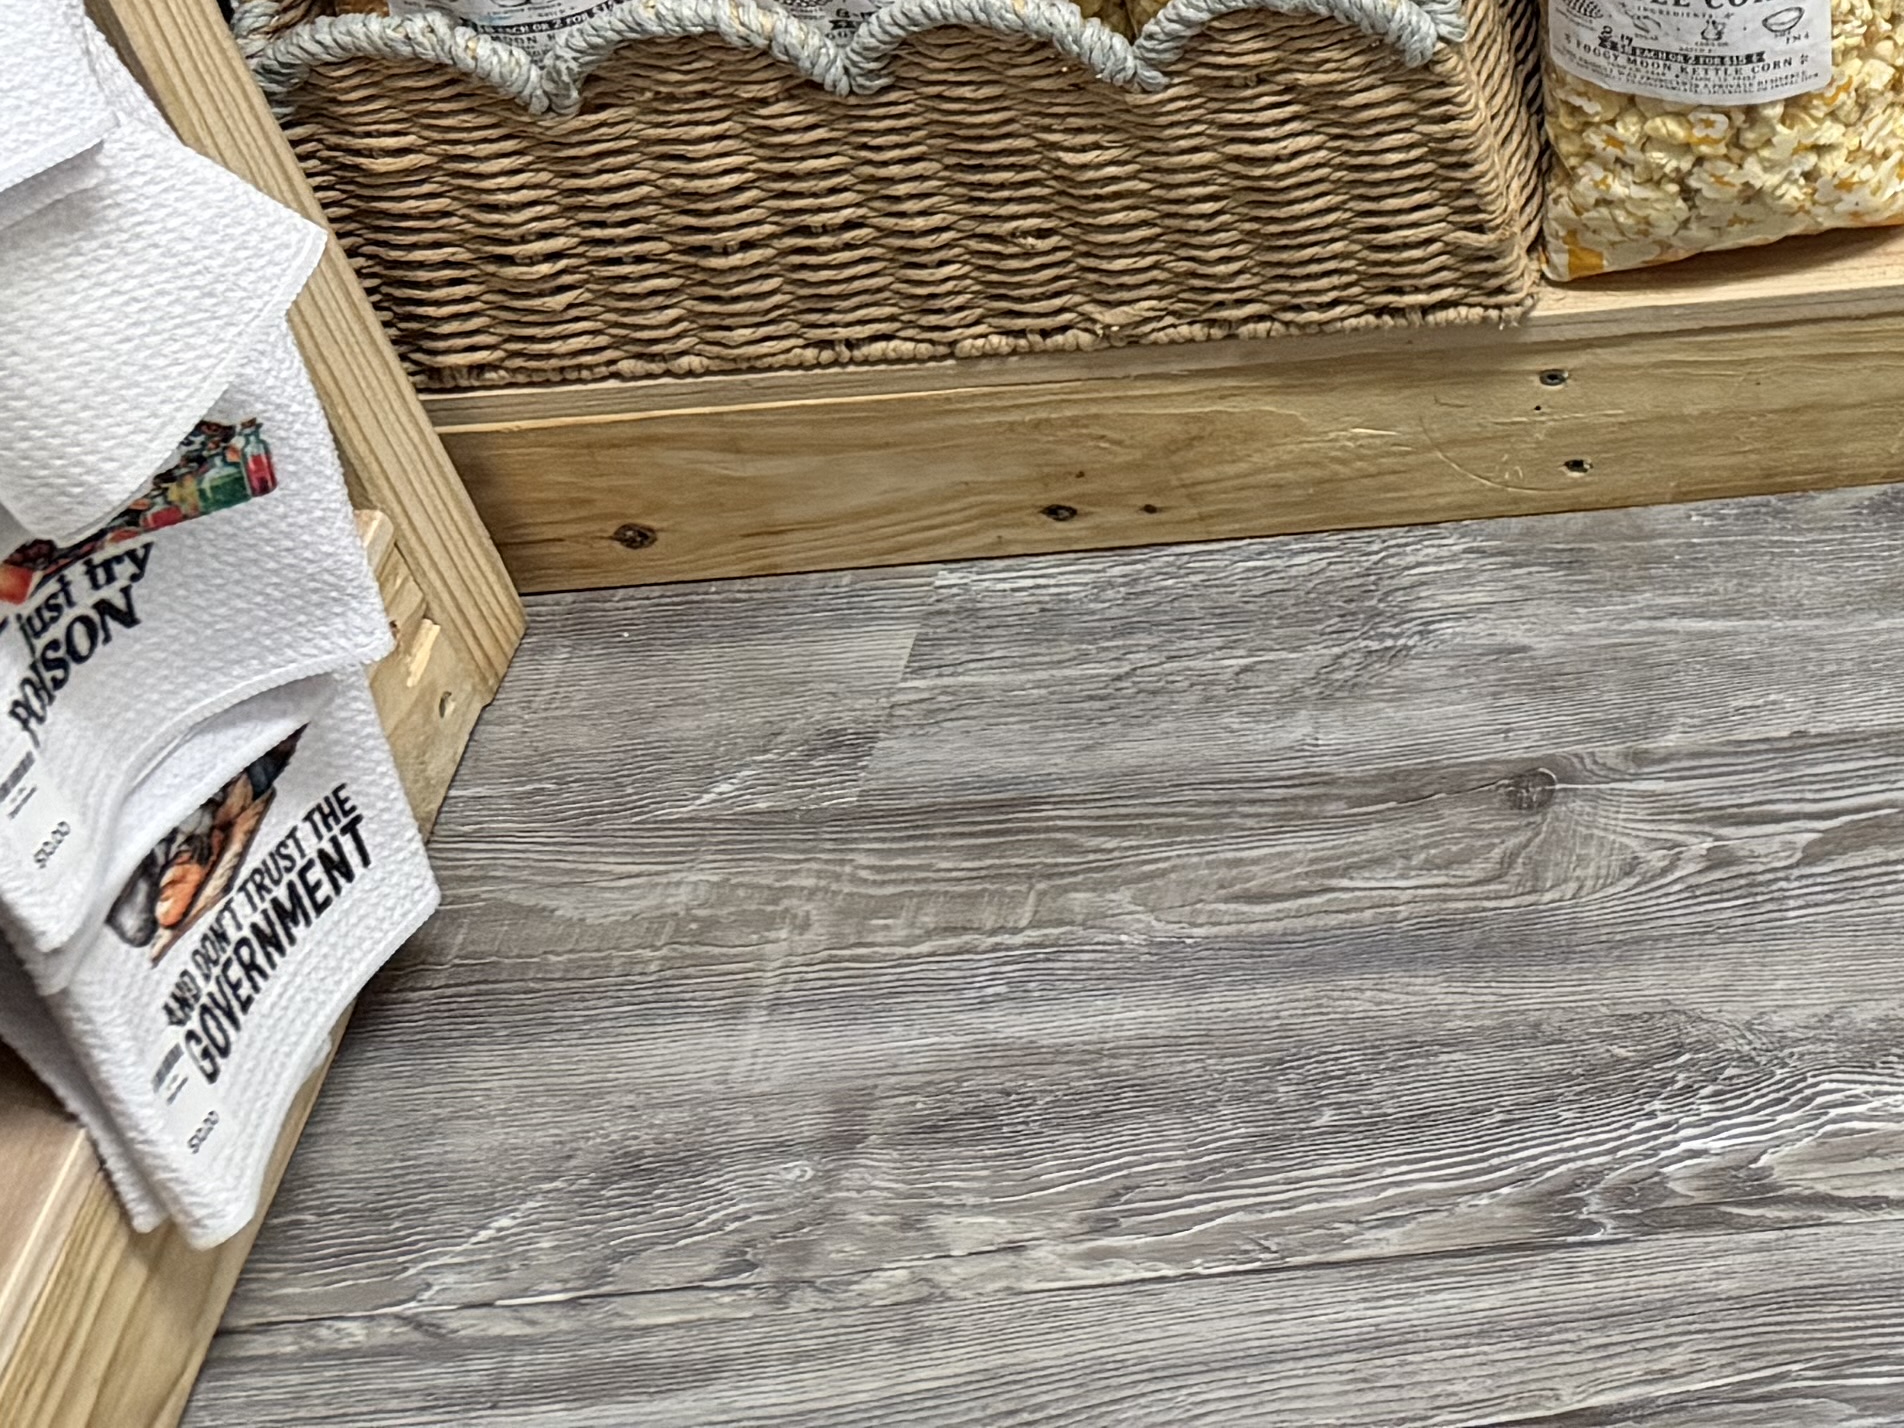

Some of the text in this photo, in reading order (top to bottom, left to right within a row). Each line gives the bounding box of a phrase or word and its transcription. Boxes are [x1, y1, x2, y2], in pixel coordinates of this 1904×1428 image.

[84, 541, 154, 591] try
[9, 584, 141, 749] POISON
[237, 825, 308, 914] TRUST
[302, 783, 357, 844] THE
[185, 814, 372, 1085] GOVERNMENT
